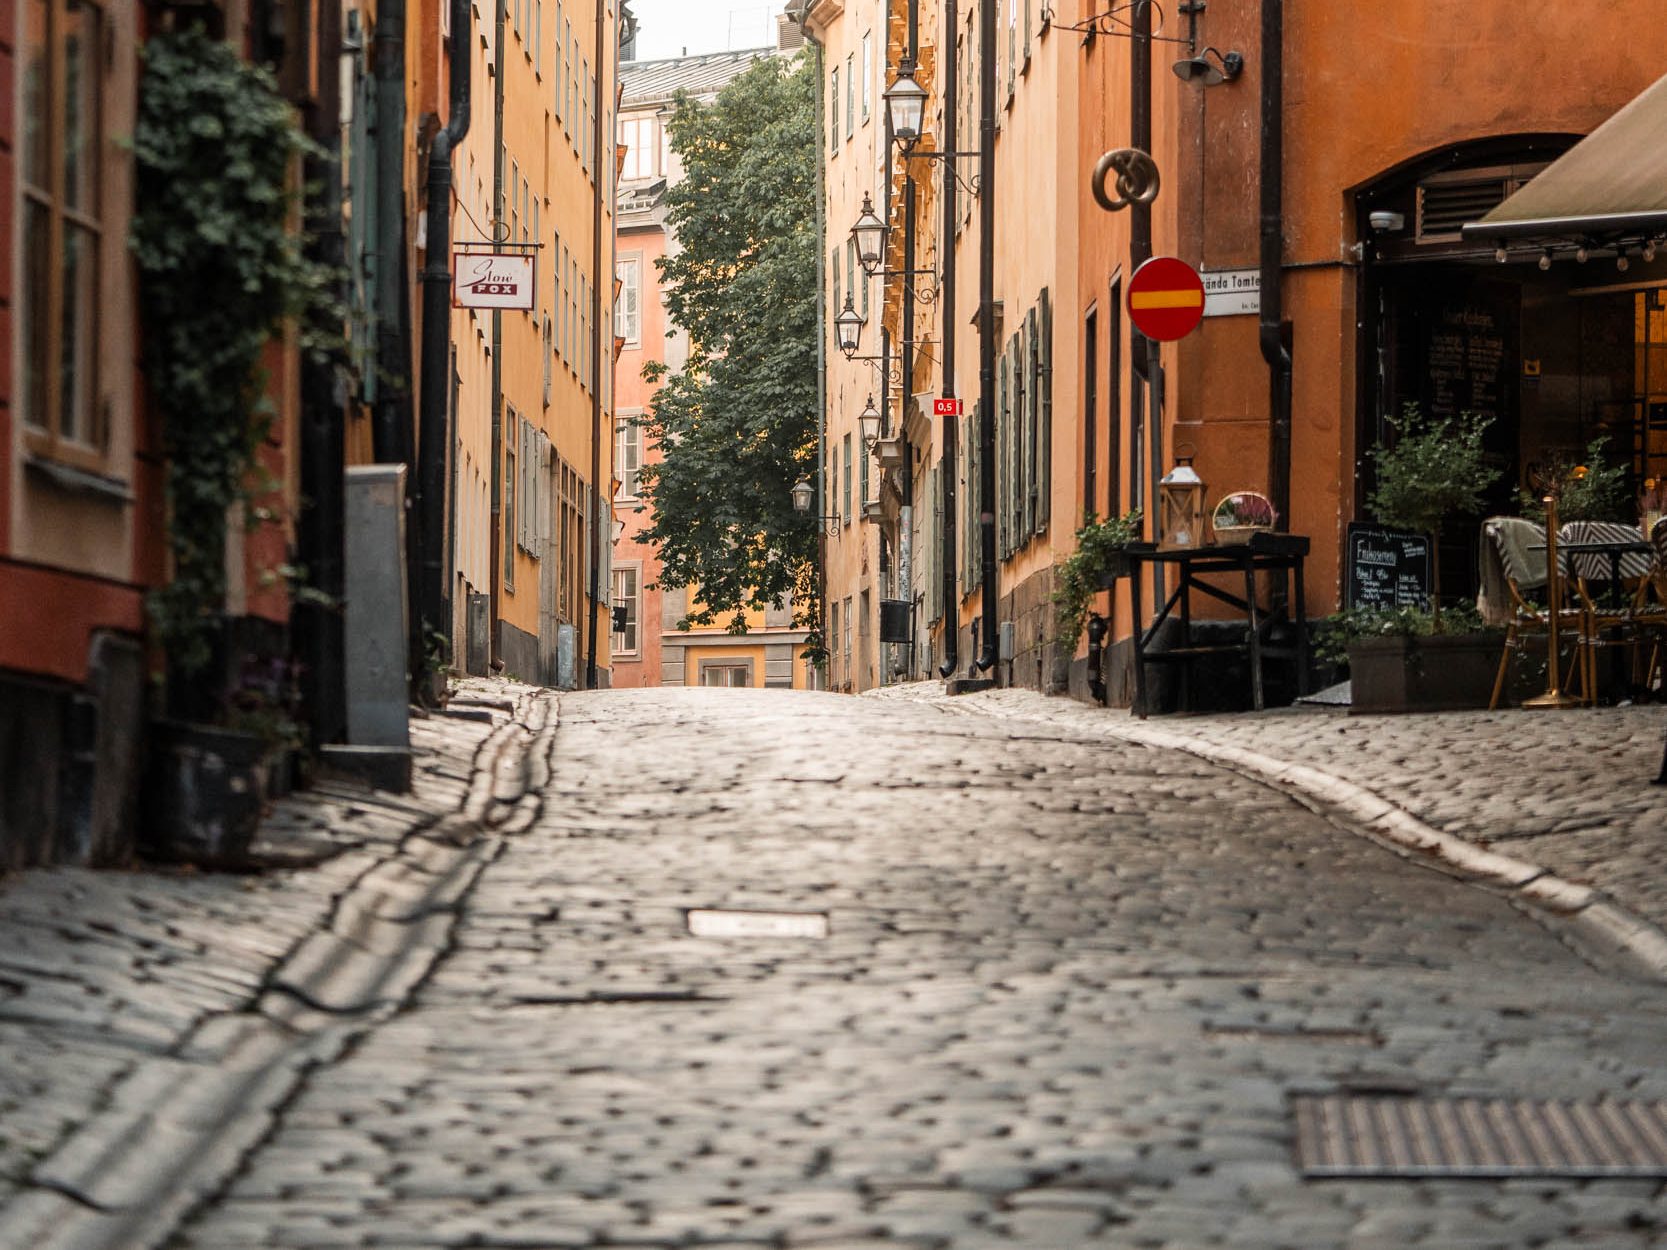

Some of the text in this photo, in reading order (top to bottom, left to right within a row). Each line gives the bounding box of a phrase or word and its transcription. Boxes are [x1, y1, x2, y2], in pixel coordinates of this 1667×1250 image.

[458, 258, 513, 288] Slow
[1201, 275, 1228, 289] ända
[477, 285, 512, 293] FOX
[937, 402, 953, 412] 0,5
